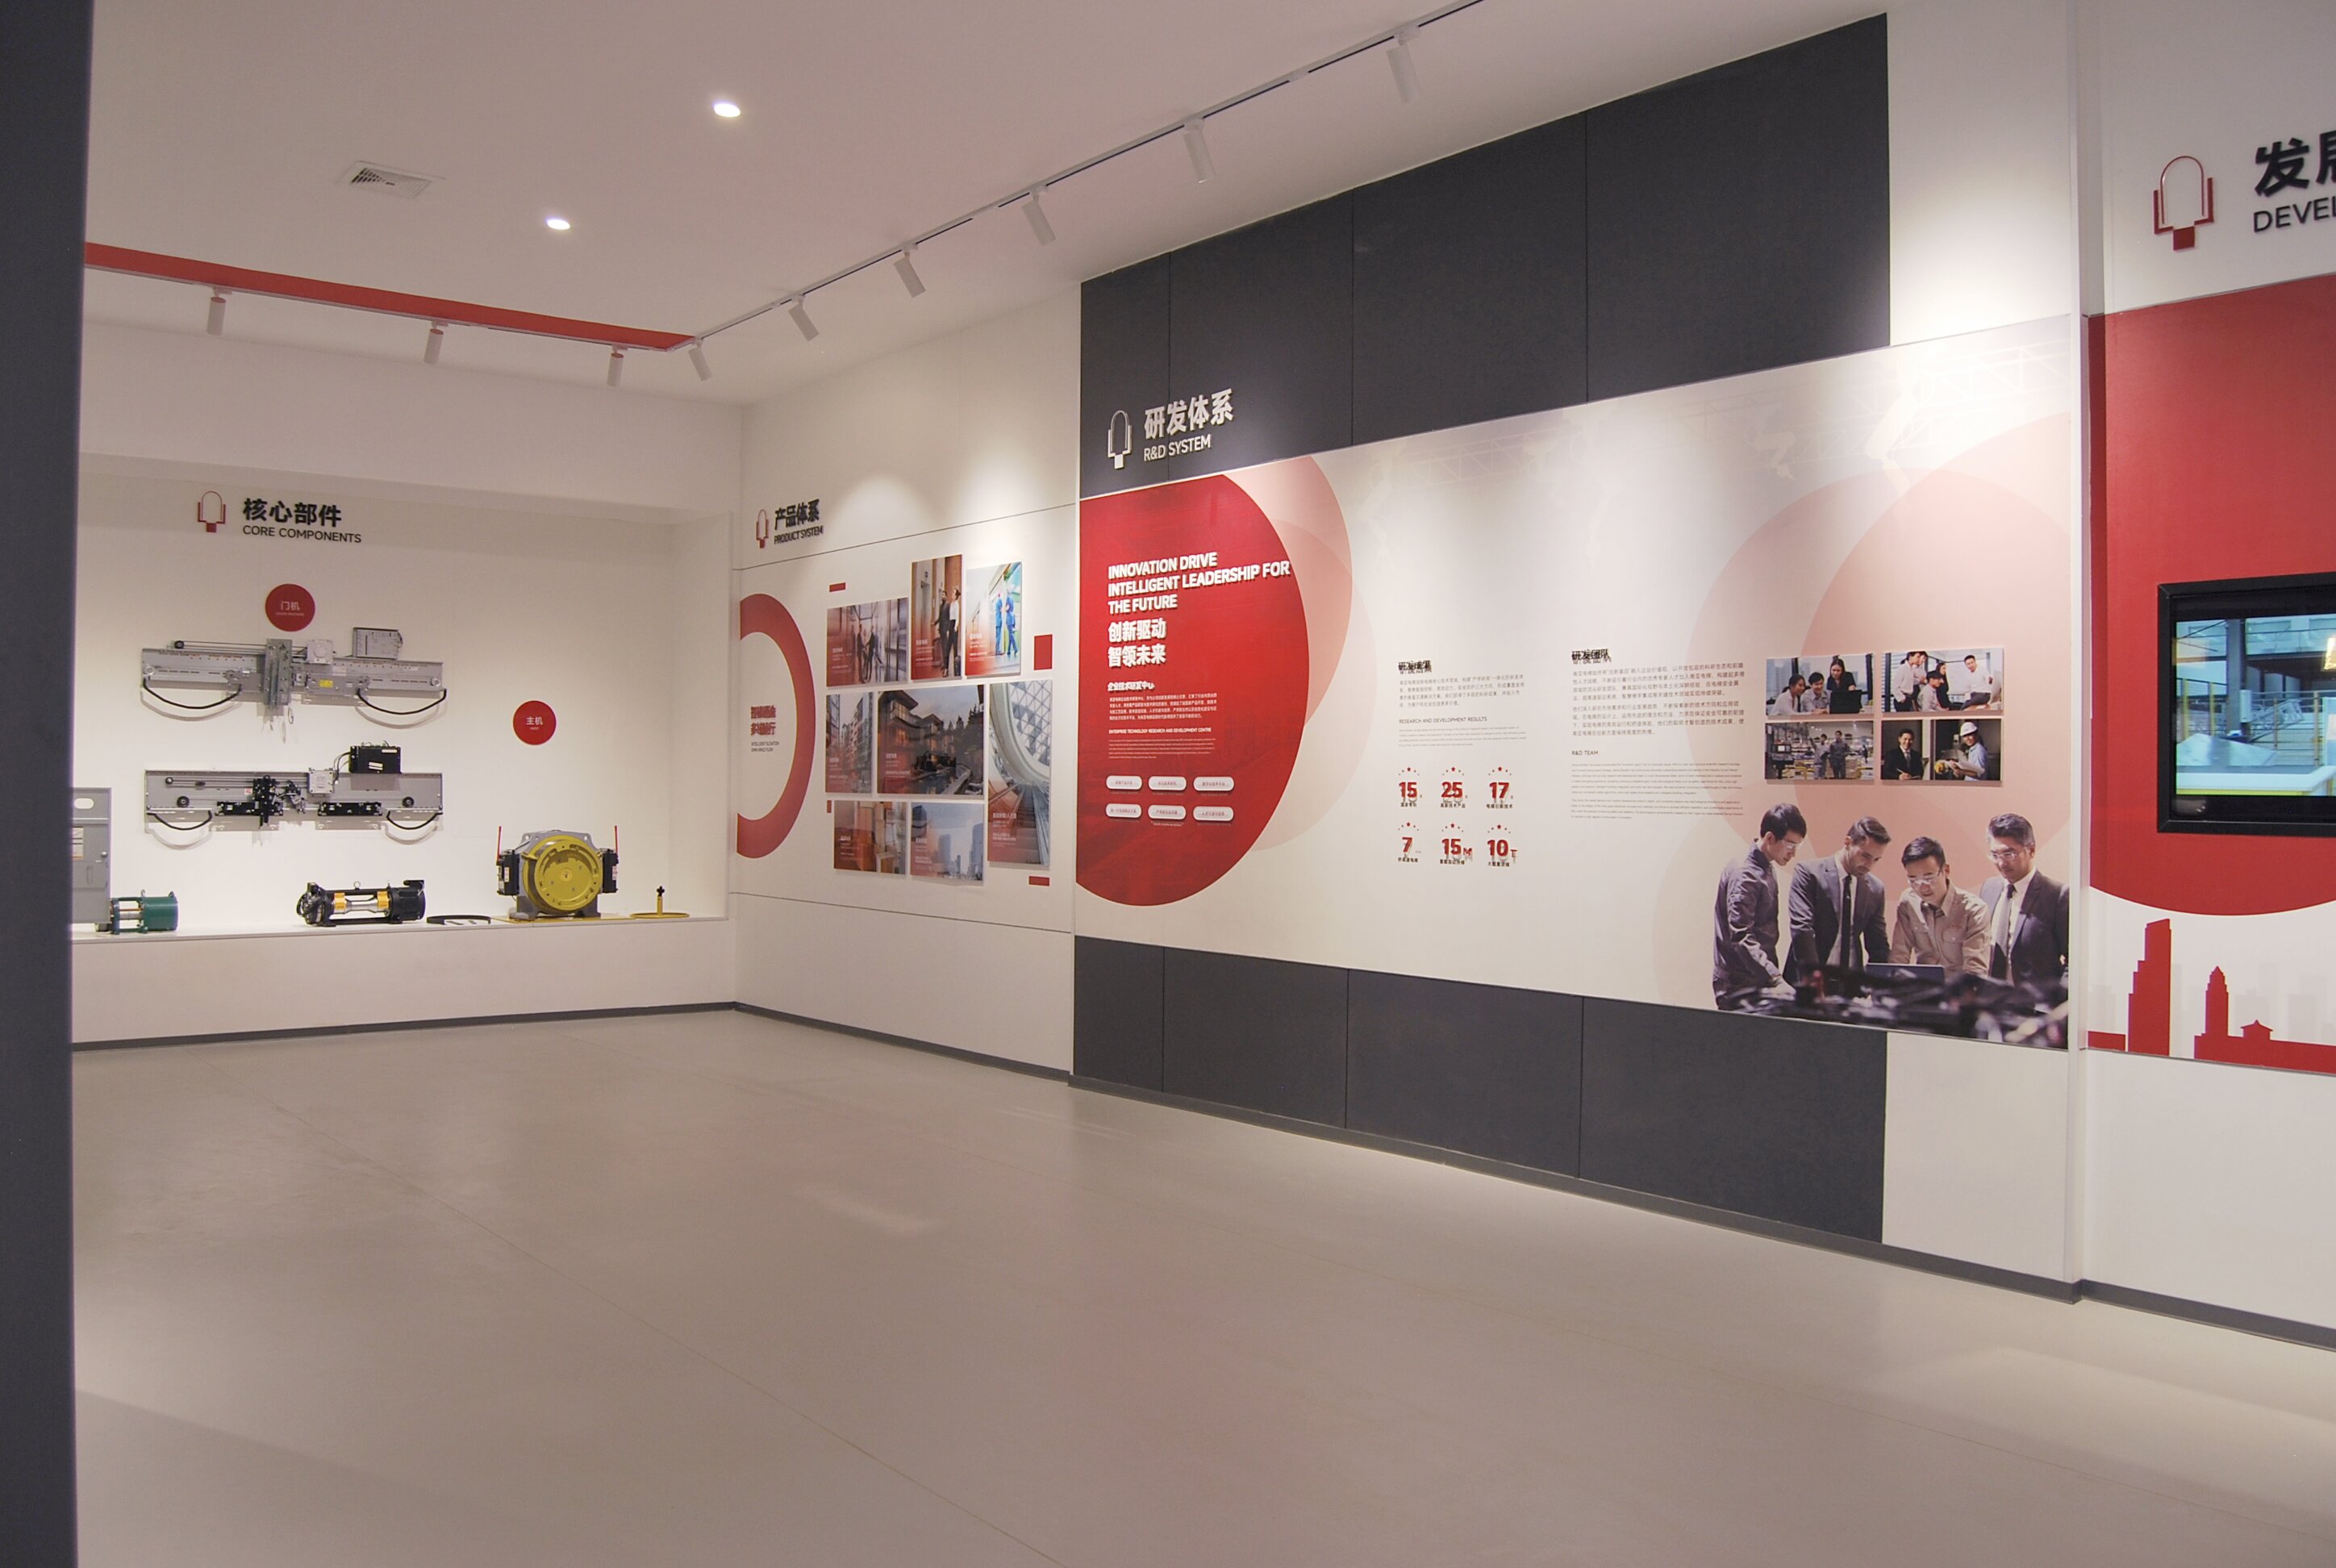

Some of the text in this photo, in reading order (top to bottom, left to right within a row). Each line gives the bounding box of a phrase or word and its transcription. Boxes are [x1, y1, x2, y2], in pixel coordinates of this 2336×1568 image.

[1144, 388, 1233, 440] 研发体系
[1144, 433, 1212, 461] R&D SYSTEM
[243, 498, 342, 528] 核心部件
[774, 498, 820, 530] 产品体系
[243, 525, 361, 543] CORE COMPONENTS
[774, 526, 823, 544] PRODUCT SYSTEM
[1108, 553, 1217, 580] INNOVATION DRIVE
[1108, 560, 1291, 598] INTELLIGENT LEADERSHIP FOR
[281, 601, 300, 611] 门机
[1108, 594, 1177, 615] THE FUTURE
[1108, 619, 1166, 644] 创新驱动
[1108, 644, 1166, 669] 智领未来
[1571, 648, 1612, 661] 研发团队
[526, 716, 543, 725] 主机
[1399, 782, 1417, 799] 15
[1441, 782, 1463, 799] 25
[1489, 782, 1510, 799] 17
[1402, 836, 1413, 853] 7
